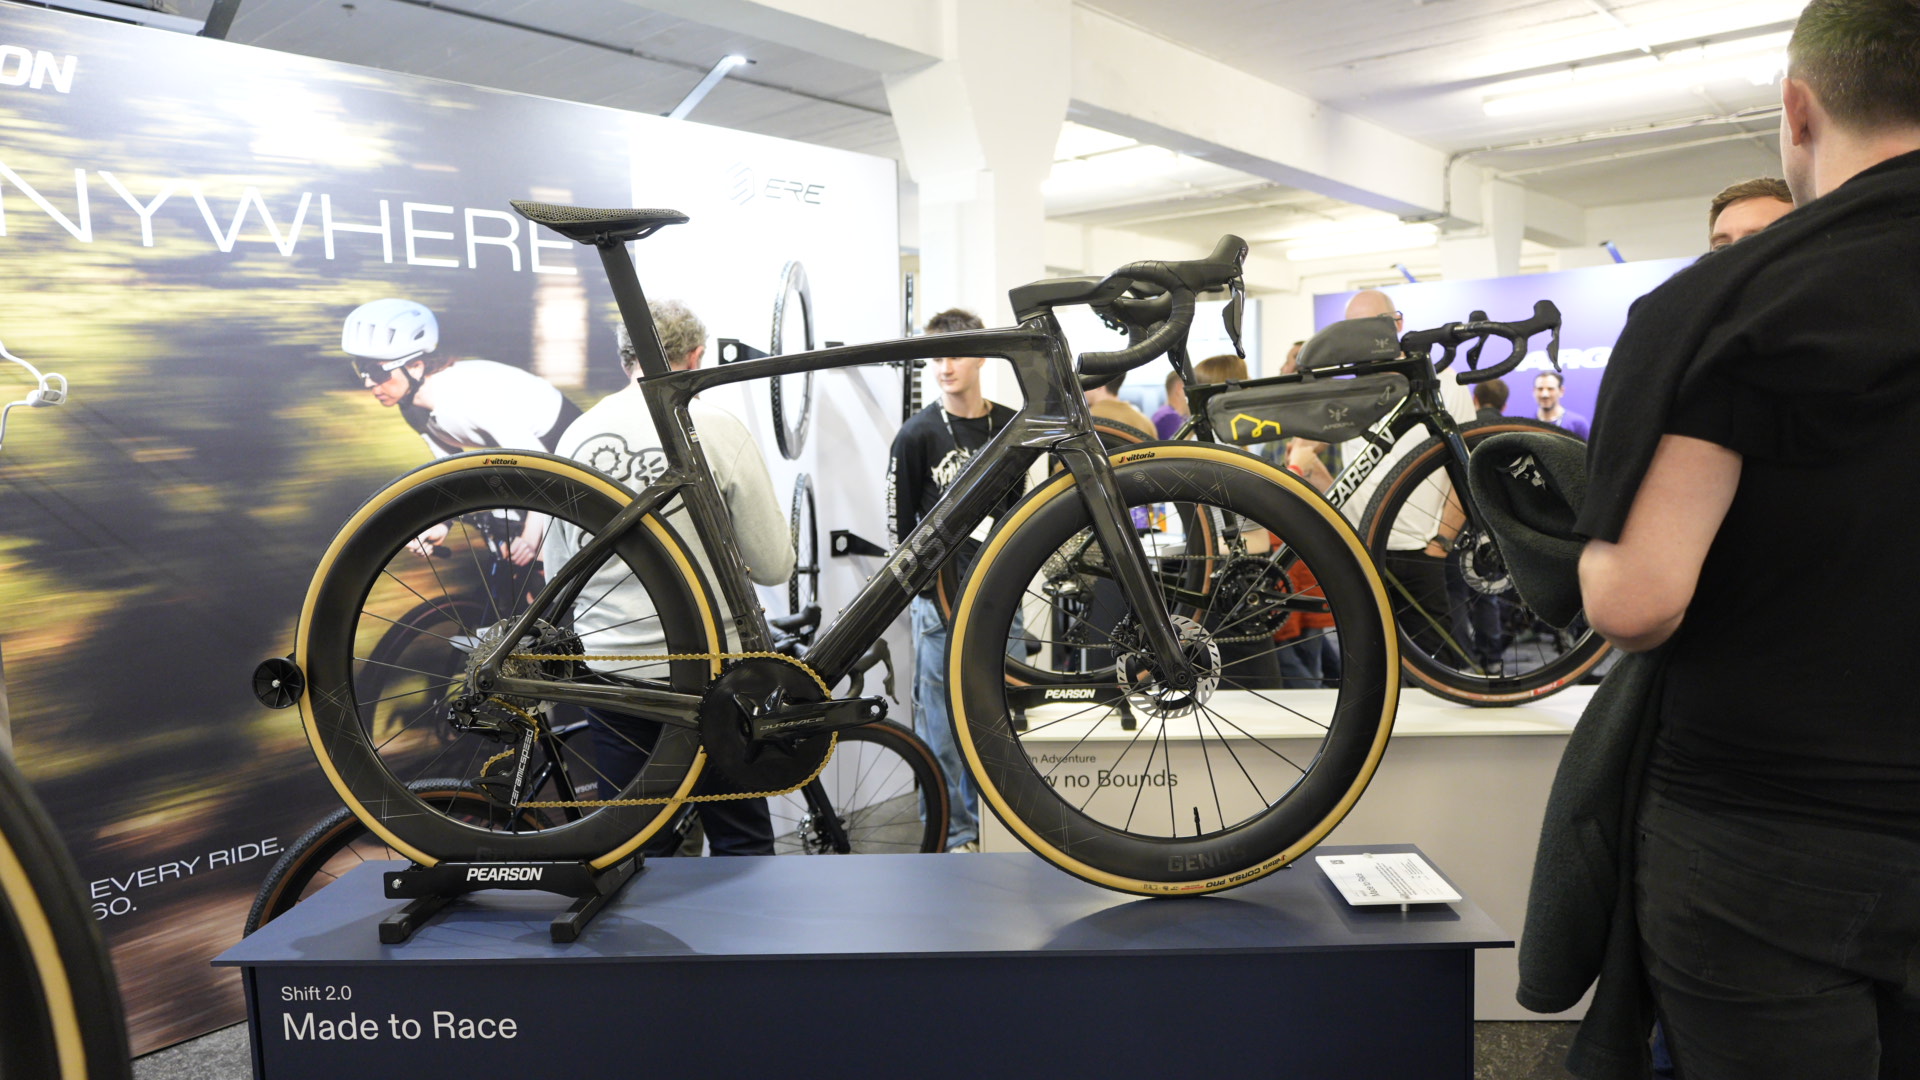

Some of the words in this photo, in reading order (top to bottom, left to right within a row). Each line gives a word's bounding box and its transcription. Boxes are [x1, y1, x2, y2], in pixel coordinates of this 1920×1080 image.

[764, 178, 825, 205] ERE
[1126, 451, 1155, 462] vittoria
[889, 498, 967, 595] PSC
[1044, 688, 1096, 700] PEARSON
[1040, 754, 1096, 764] Adventure
[1064, 774, 1090, 788] no
[1098, 769, 1178, 788] Bounds
[90, 856, 200, 899] EVERY
[208, 837, 285, 870] RIDE.
[466, 867, 543, 882] PEARSON
[1229, 868, 1261, 882] CORSA
[1206, 879, 1226, 888] PRO
[281, 985, 321, 1001] Shift
[325, 985, 352, 1001] 2.0
[282, 1012, 379, 1041] Made
[388, 1013, 421, 1040] to
[432, 1010, 517, 1039] Race
